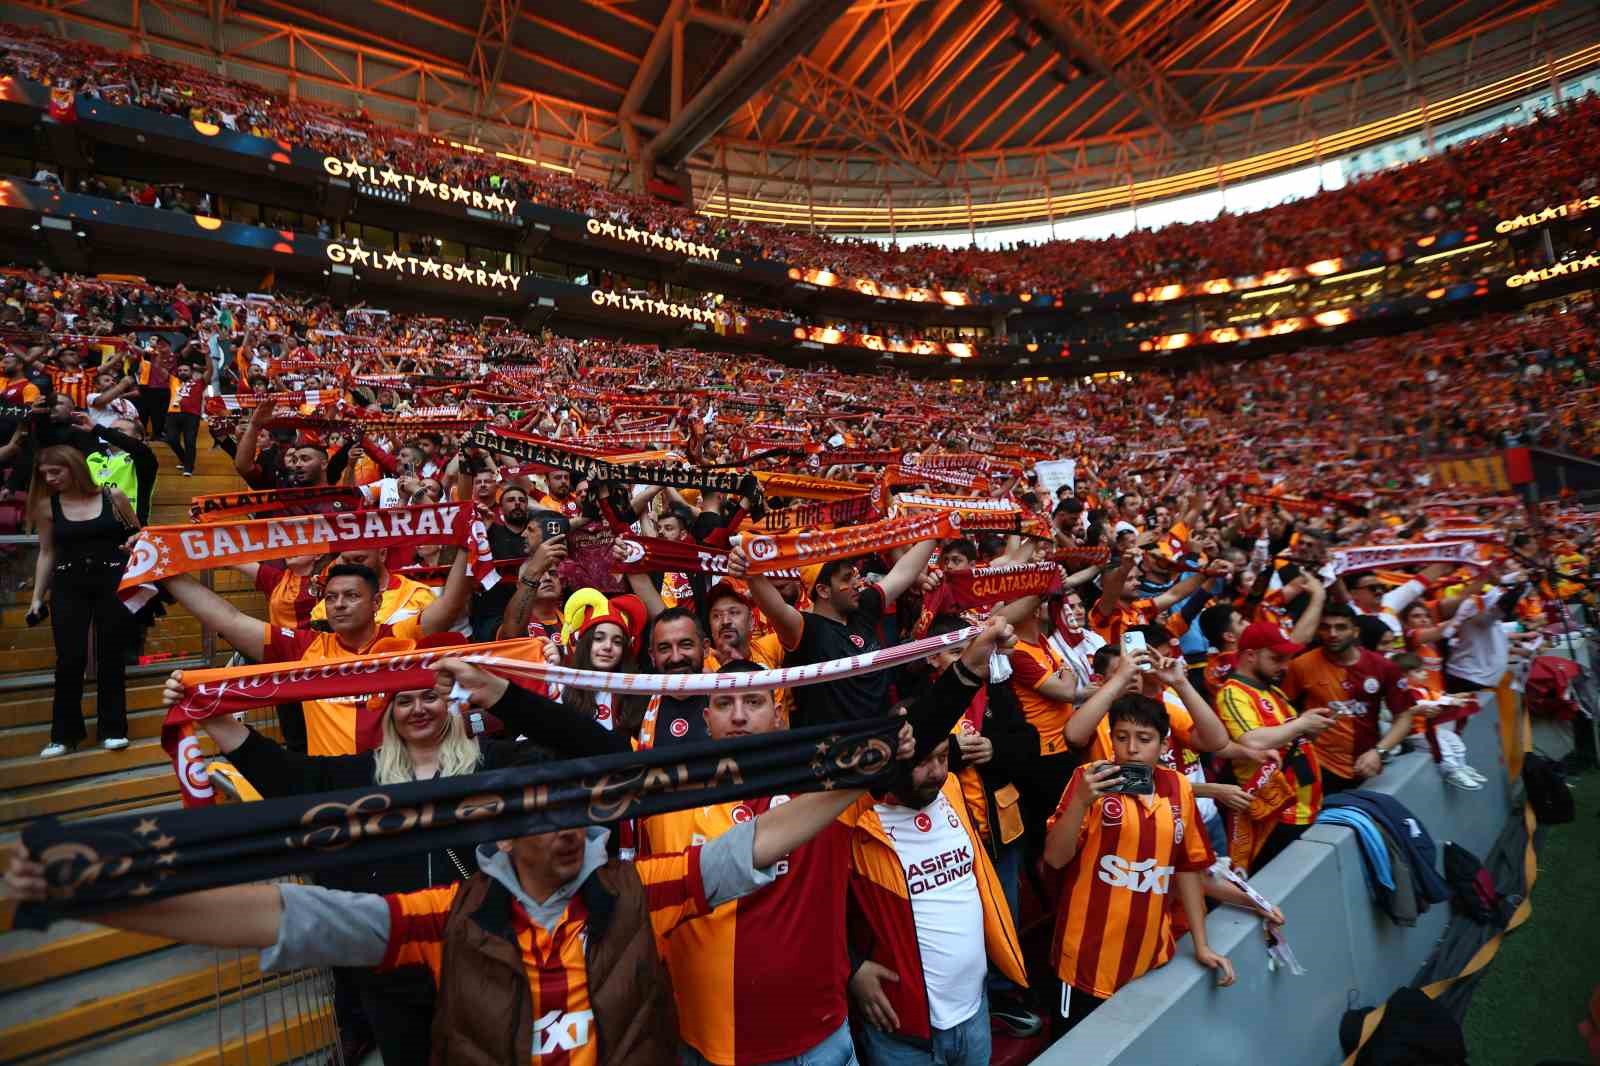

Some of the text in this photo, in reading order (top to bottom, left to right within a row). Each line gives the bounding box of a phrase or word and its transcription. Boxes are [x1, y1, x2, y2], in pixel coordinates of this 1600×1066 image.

[323, 156, 517, 215] GALATASARAY
[586, 218, 720, 261] GALATASARAY
[326, 243, 521, 291] GALATASARAY
[180, 506, 460, 560] GALATASARAY
